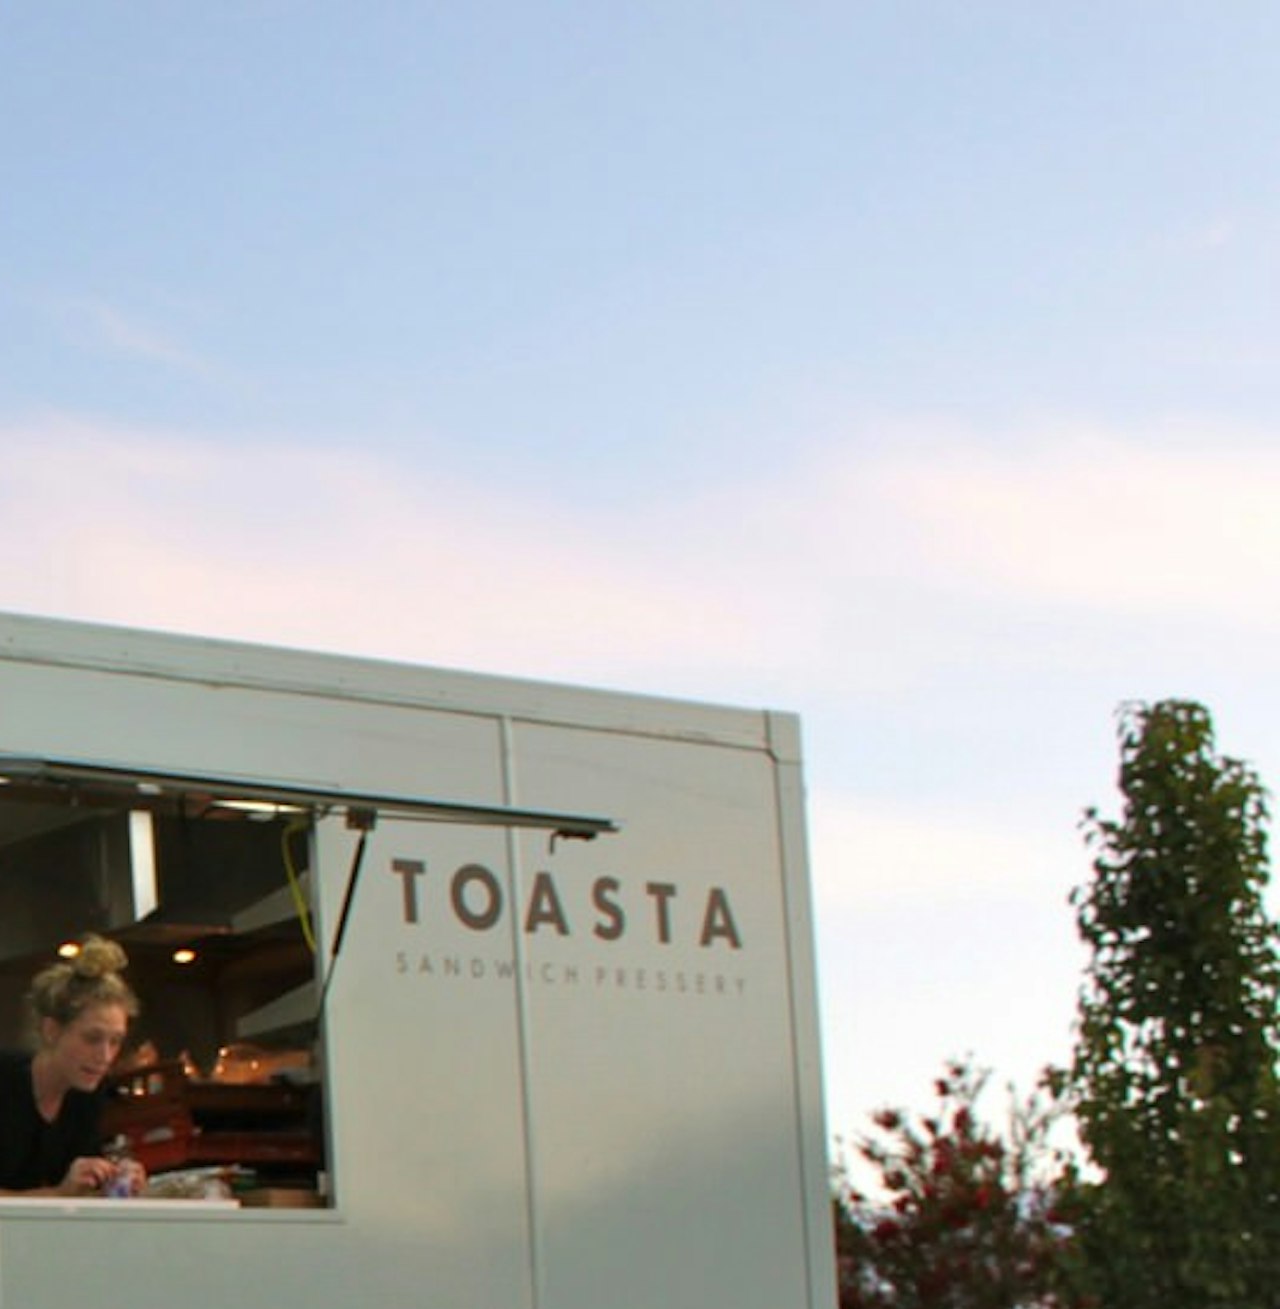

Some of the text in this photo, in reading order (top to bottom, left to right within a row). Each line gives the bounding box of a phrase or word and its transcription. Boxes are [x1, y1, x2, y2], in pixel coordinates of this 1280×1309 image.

[391, 859, 742, 949] TOASTA
[395, 952, 745, 995] SANDWICH PRESSERY
